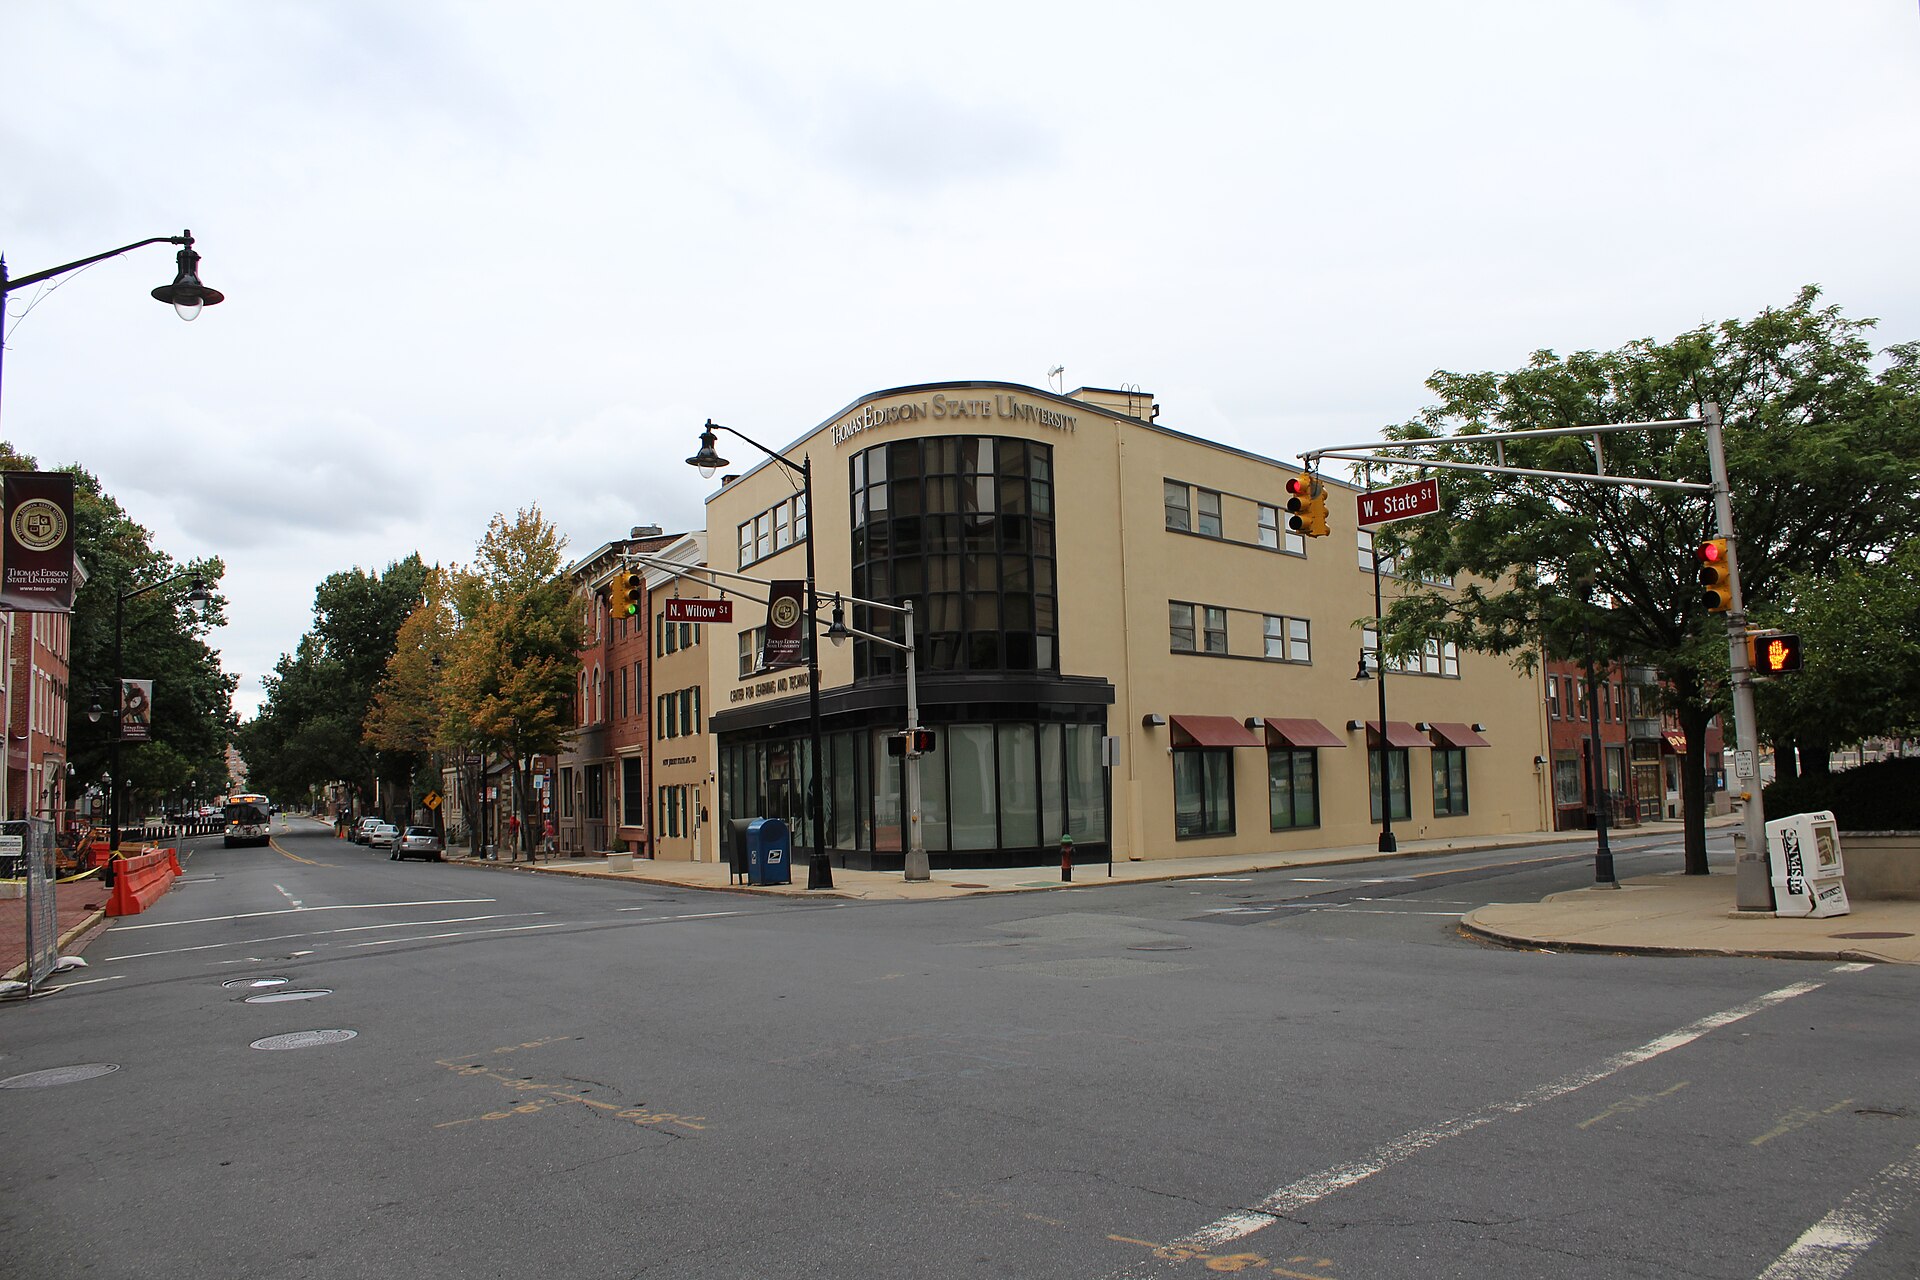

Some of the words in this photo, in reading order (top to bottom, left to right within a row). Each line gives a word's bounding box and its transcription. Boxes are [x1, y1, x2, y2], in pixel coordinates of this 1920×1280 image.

[830, 415, 862, 446] THOMAS
[863, 402, 927, 429] EDISON
[932, 394, 992, 418] STATE
[995, 394, 1077, 433] UNIVERSITY
[1363, 500, 1379, 518] W.
[1384, 492, 1418, 514] State
[1421, 487, 1432, 500] St
[7, 567, 40, 577] THOMAS
[41, 568, 69, 577] EDISON
[7, 576, 28, 584] STATE
[28, 575, 69, 584] UNIVERSITY
[670, 603, 681, 616] N.
[685, 604, 716, 618] Willow
[719, 605, 728, 614] St
[745, 686, 755, 700] FOR
[777, 678, 788, 693] AND
